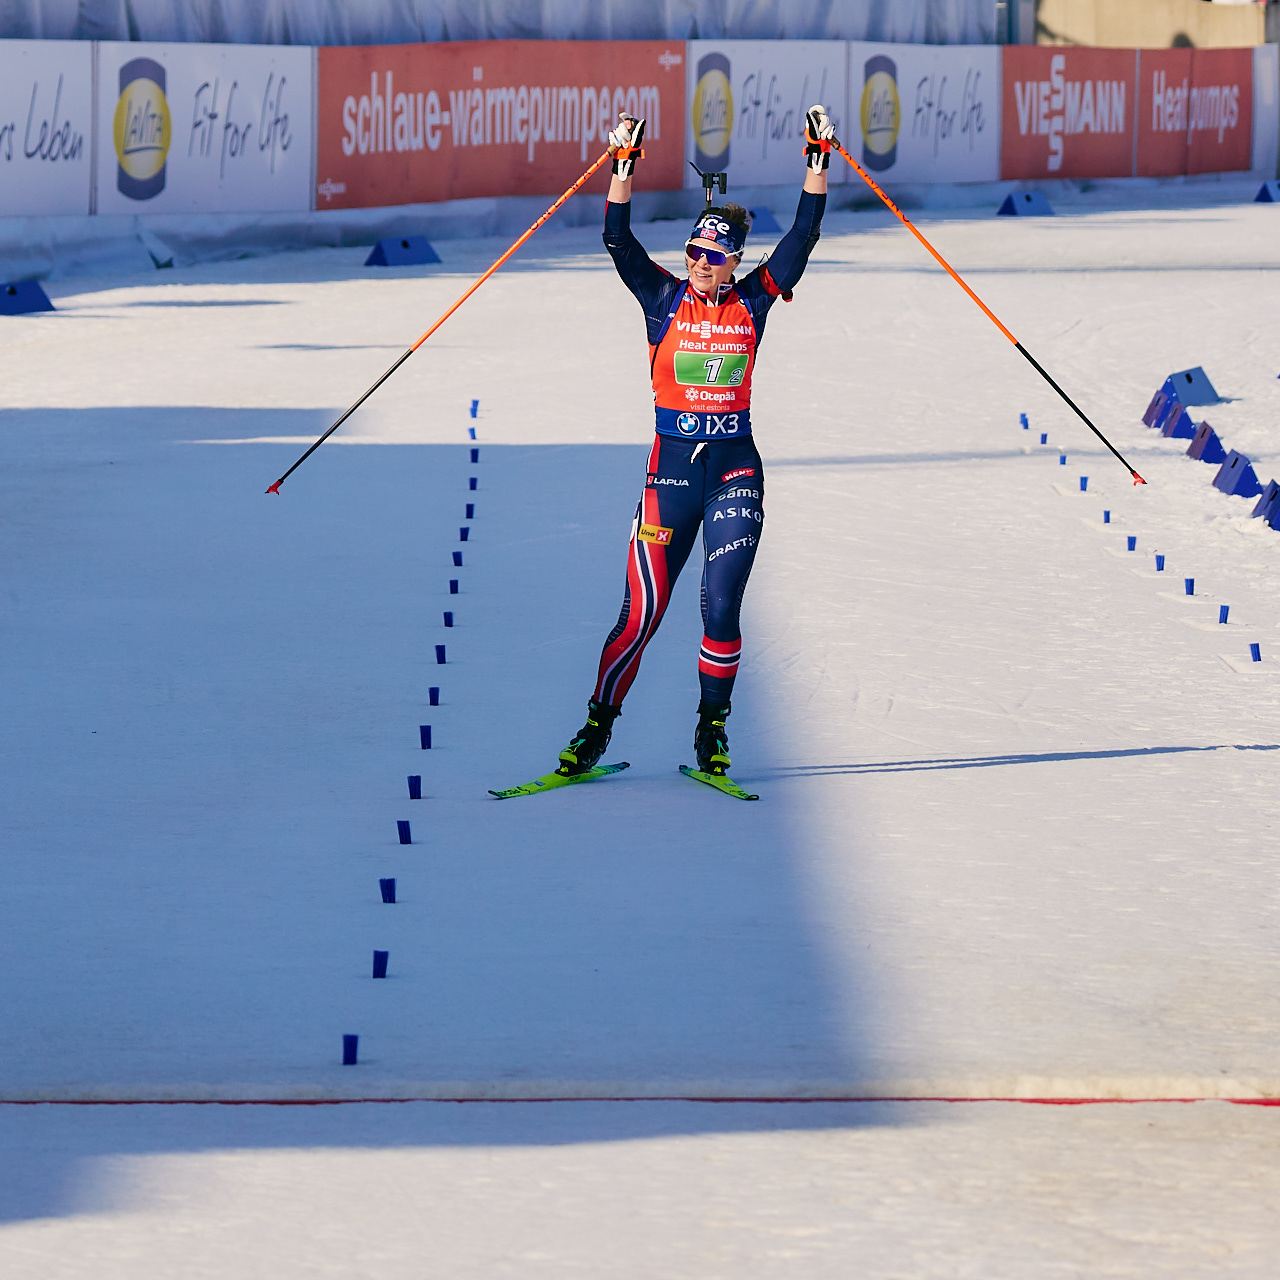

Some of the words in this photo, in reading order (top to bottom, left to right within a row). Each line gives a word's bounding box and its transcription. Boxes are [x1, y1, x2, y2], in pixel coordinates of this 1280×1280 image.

[24, 73, 83, 161] Leben
[188, 77, 219, 157] Fit
[220, 80, 252, 180] for
[676, 321, 752, 339] VIESSMANN
[679, 339, 707, 351] Heat
[710, 343, 747, 353] pumps
[704, 357, 724, 383] 1
[729, 368, 742, 383] 2
[700, 391, 736, 403] Otepää
[705, 414, 739, 434] iX3
[654, 478, 689, 486] LAPUA
[641, 528, 655, 537] Uno
[708, 538, 747, 561] CRAFT
